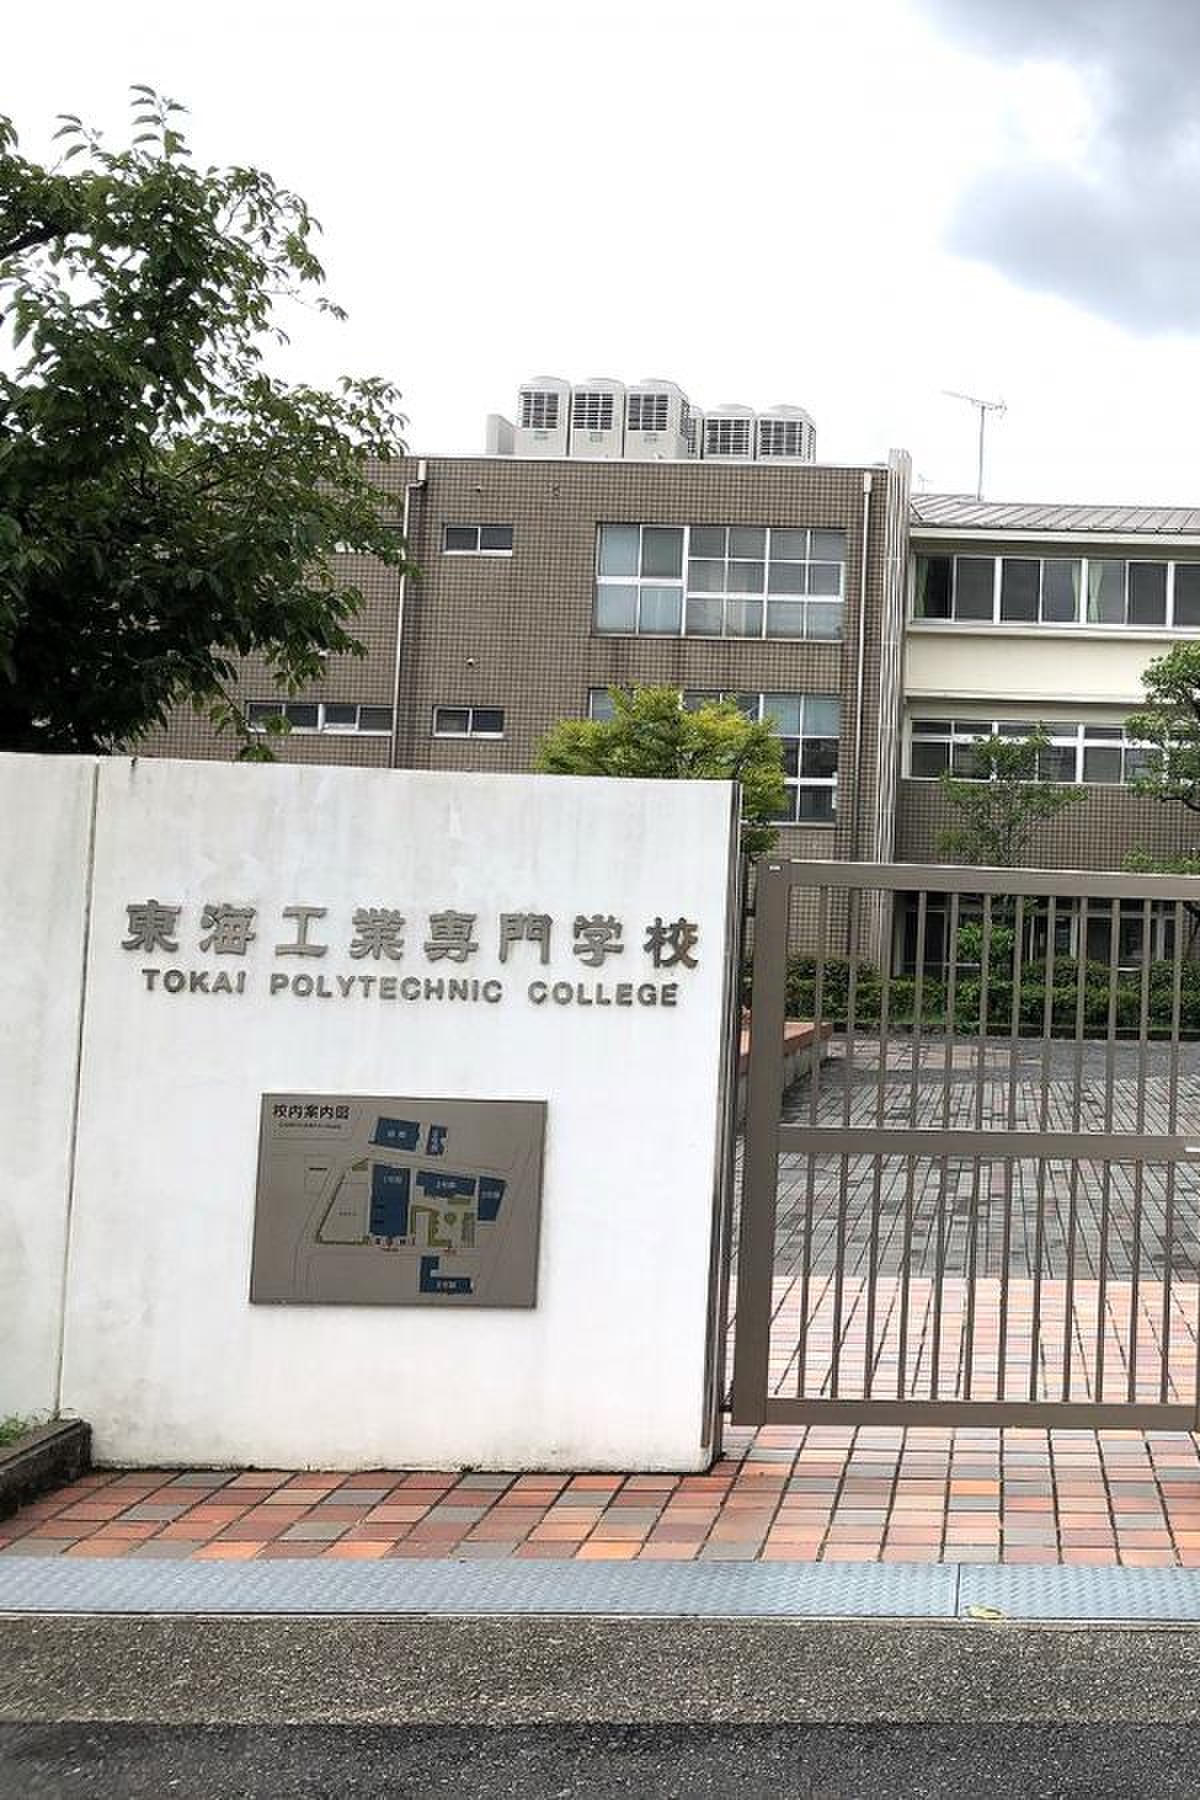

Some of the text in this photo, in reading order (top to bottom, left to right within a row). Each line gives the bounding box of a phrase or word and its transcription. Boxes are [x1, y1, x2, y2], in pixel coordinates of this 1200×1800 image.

[120, 899, 700, 969] 東海工業専門学校
[142, 968, 679, 1007] TOKAI POLYTECHNIC COLLEGE
[273, 1104, 350, 1120] 校内案内図
